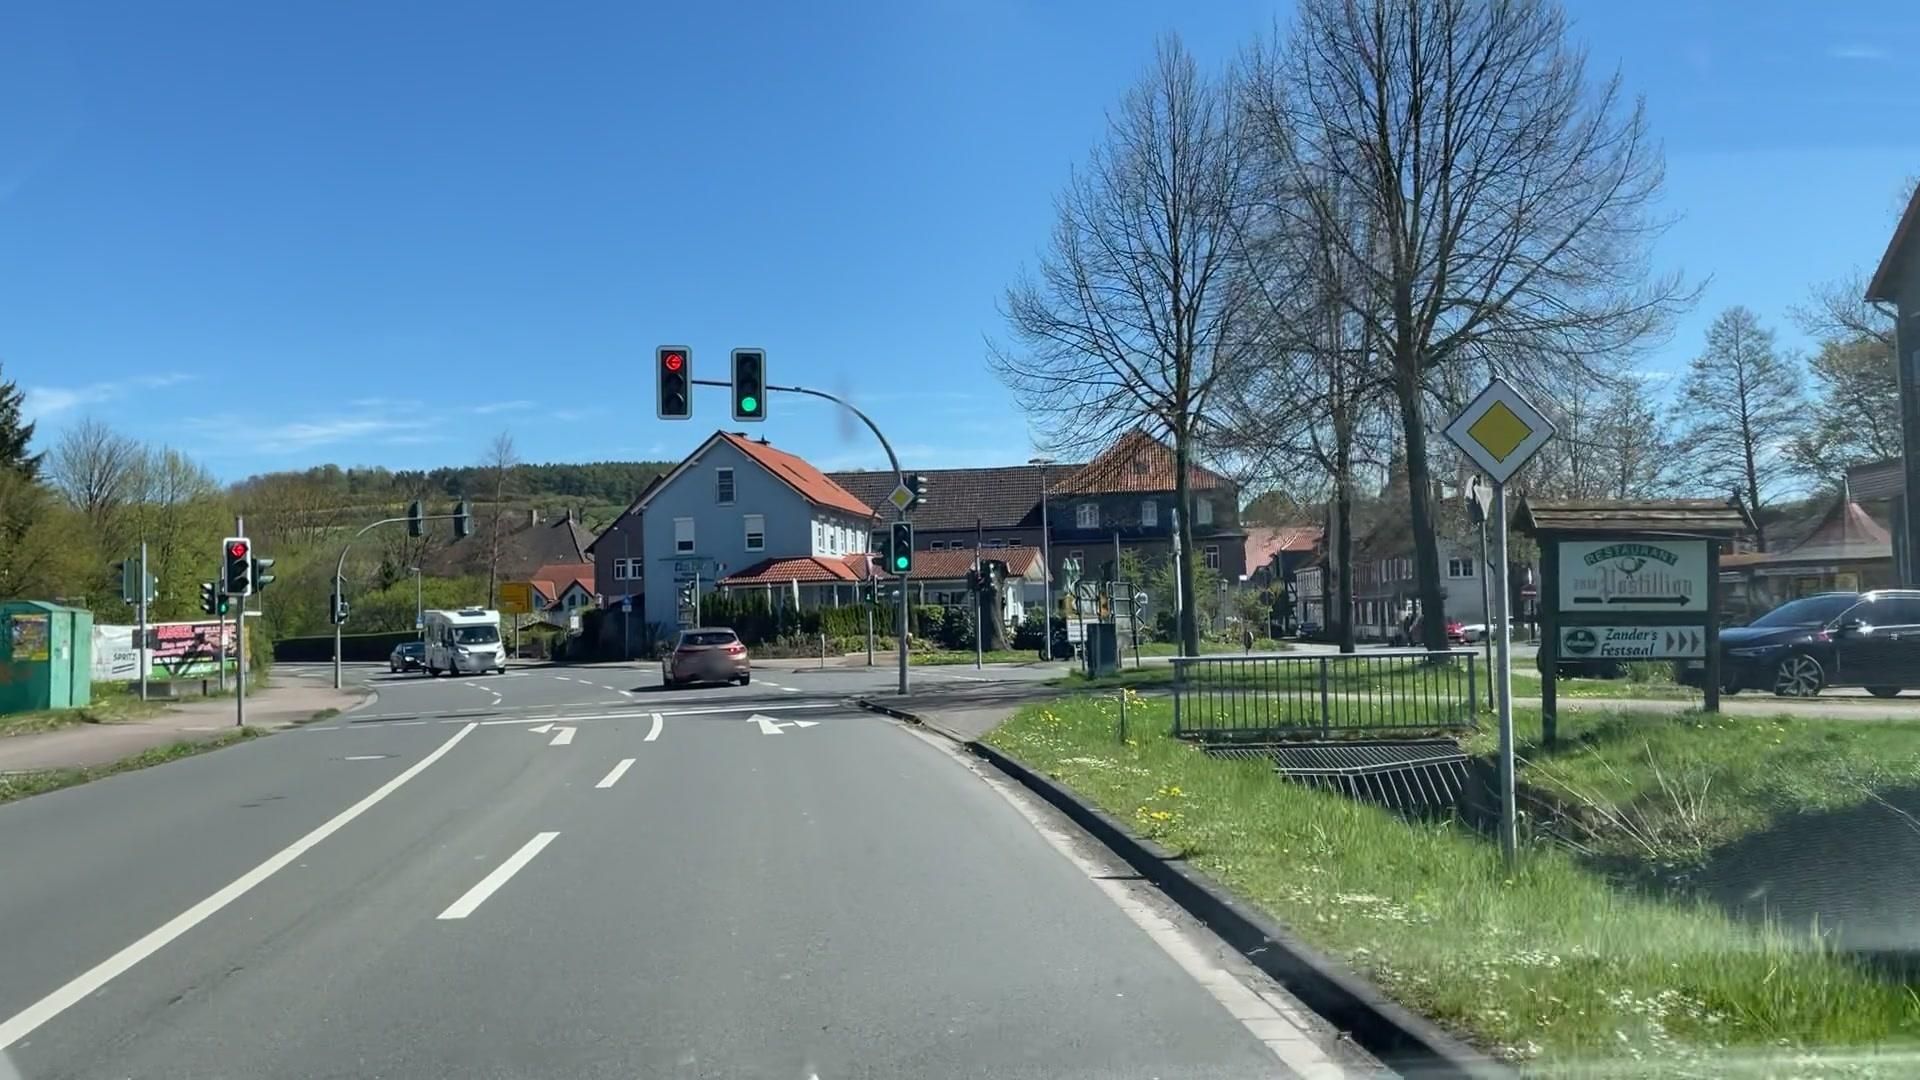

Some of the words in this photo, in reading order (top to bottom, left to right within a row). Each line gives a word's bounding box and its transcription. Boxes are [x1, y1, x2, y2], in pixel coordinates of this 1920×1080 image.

[1585, 545, 1676, 565] RESTAURANT
[1597, 566, 1692, 598] Postillion
[1606, 628, 1658, 641] Zander's
[1600, 643, 1655, 656] Festsaal
